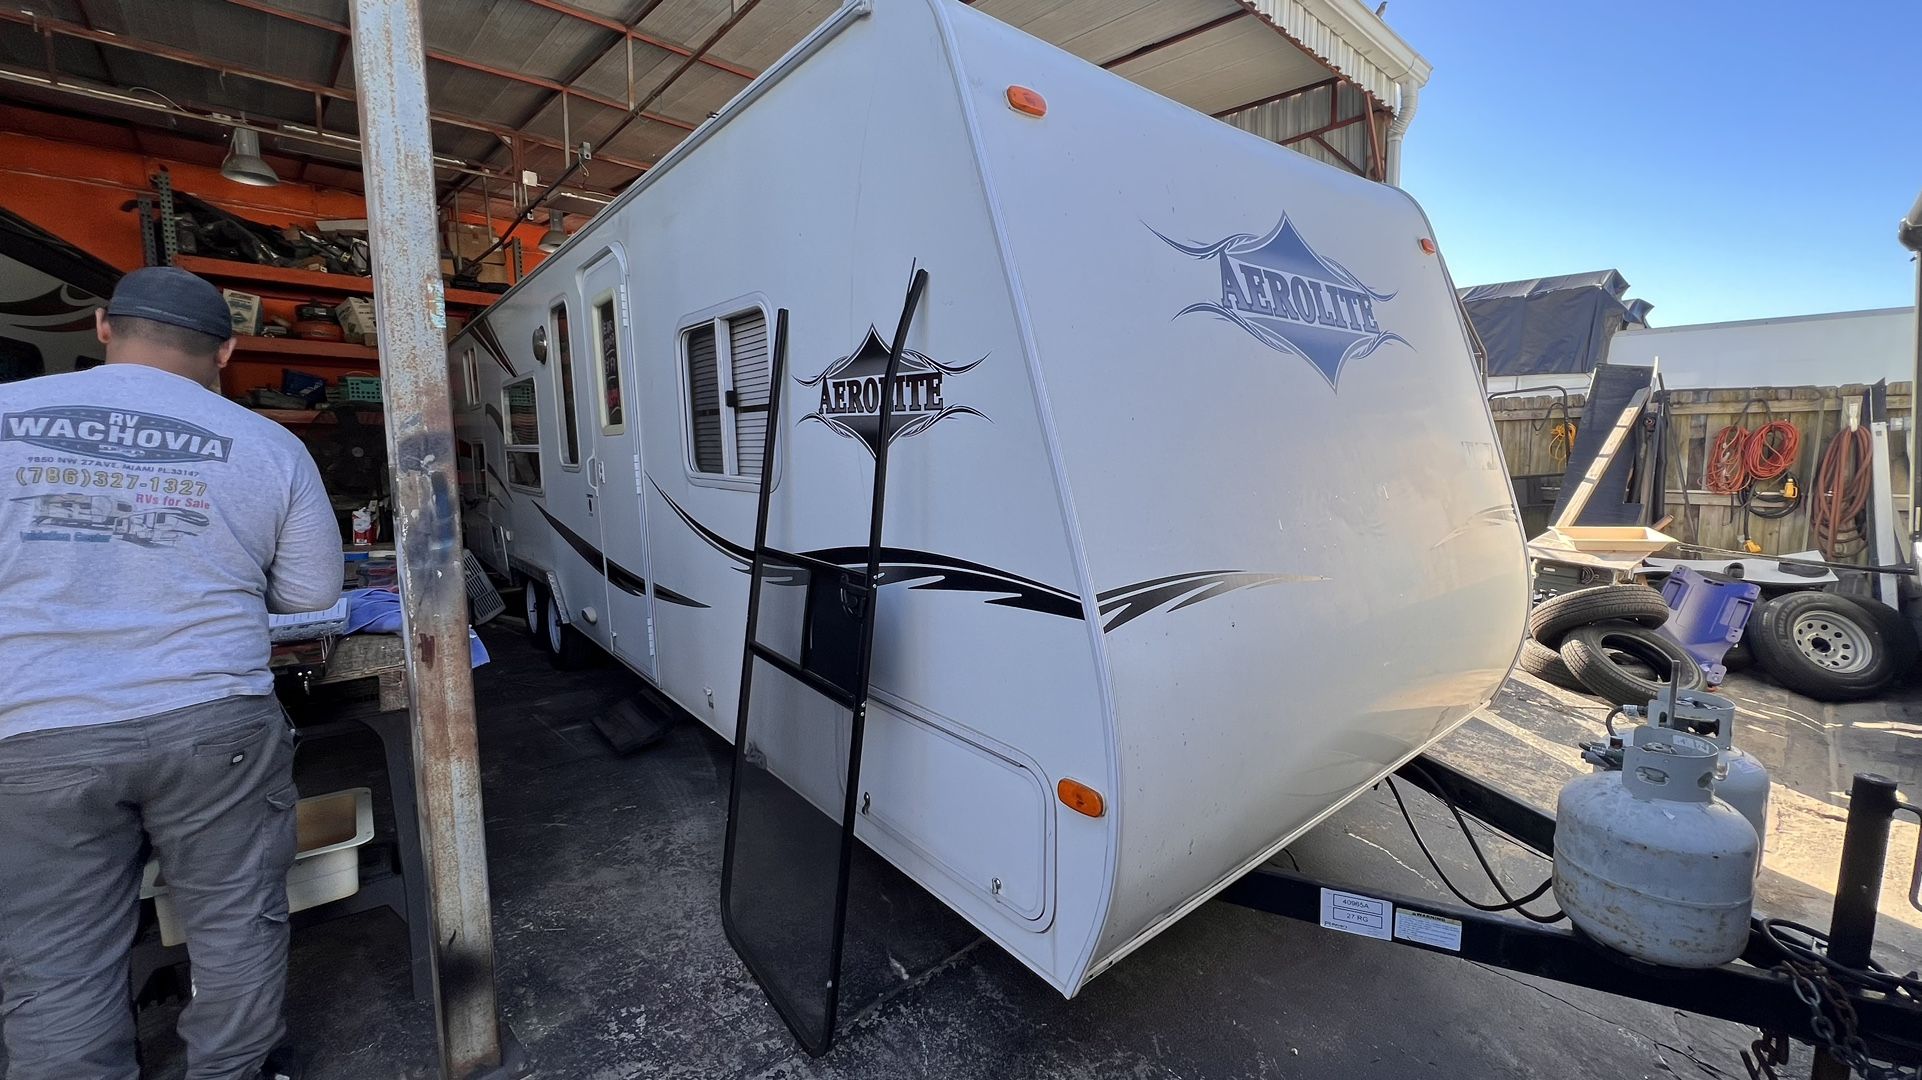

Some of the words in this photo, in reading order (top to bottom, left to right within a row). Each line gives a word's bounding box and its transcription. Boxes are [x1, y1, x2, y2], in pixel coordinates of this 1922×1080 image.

[1219, 250, 1380, 333] AEROLITE
[109, 413, 139, 426] RV
[9, 417, 223, 457] WACHOVIA
[57, 457, 78, 465] NW
[122, 464, 155, 472] MIAMI
[16, 466, 208, 496] (786)327-1327
[136, 494, 159, 505] RVs
[163, 495, 181, 507] for
[185, 498, 210, 510] Sale
